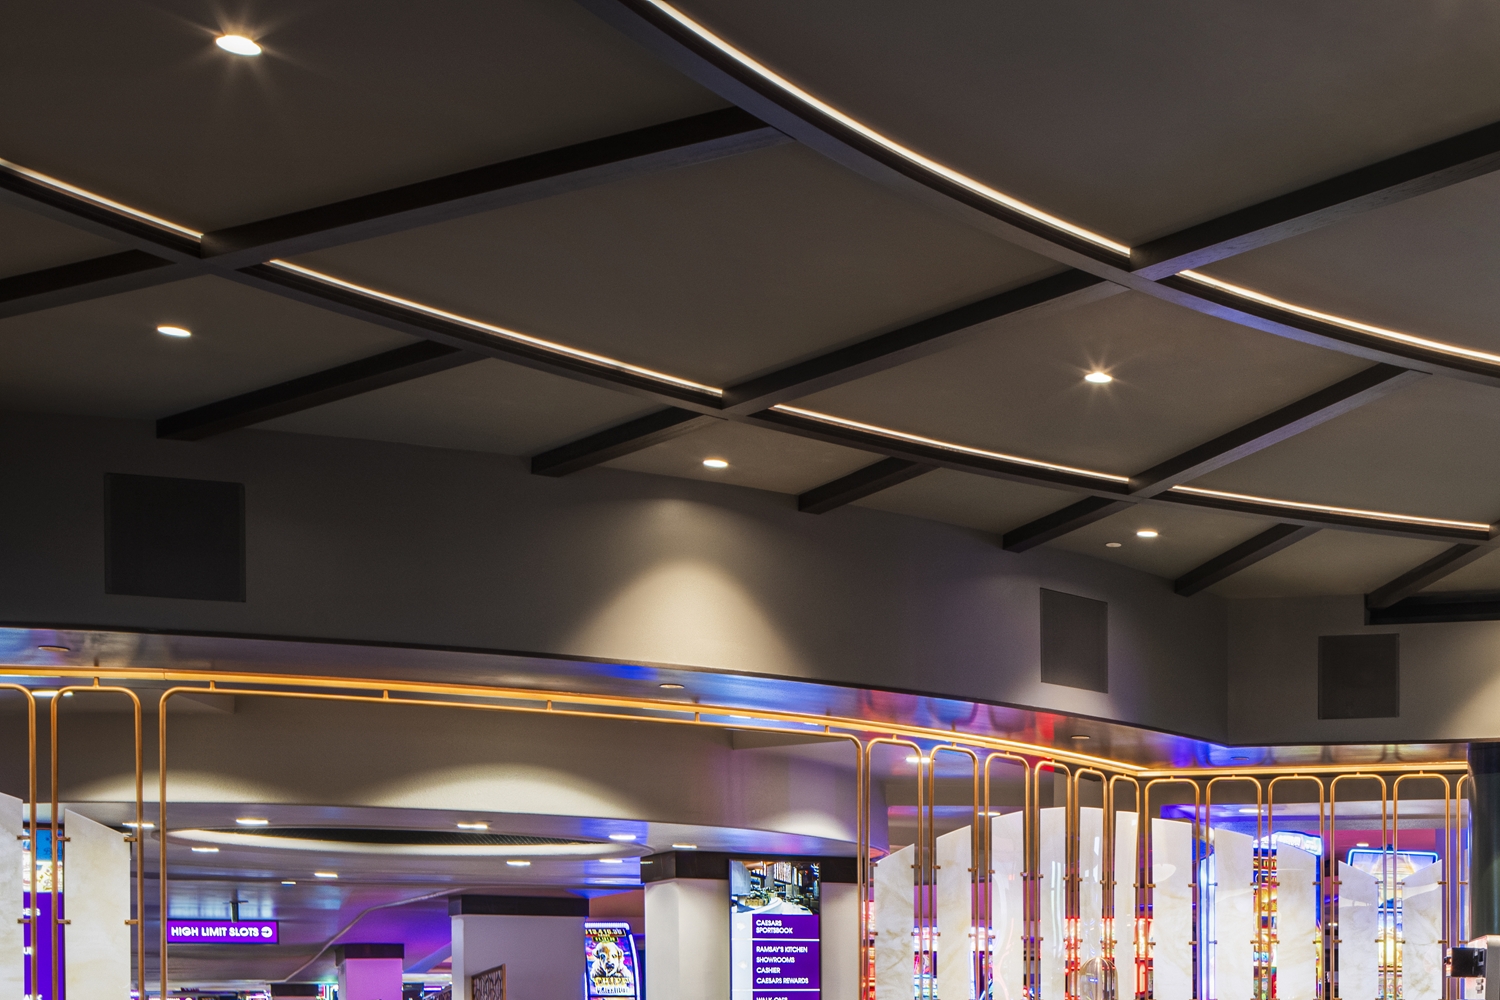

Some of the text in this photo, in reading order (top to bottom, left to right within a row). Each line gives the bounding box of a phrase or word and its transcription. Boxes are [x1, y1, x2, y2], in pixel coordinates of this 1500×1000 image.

[171, 926, 259, 937] HIGH LIMIT SLOTS
